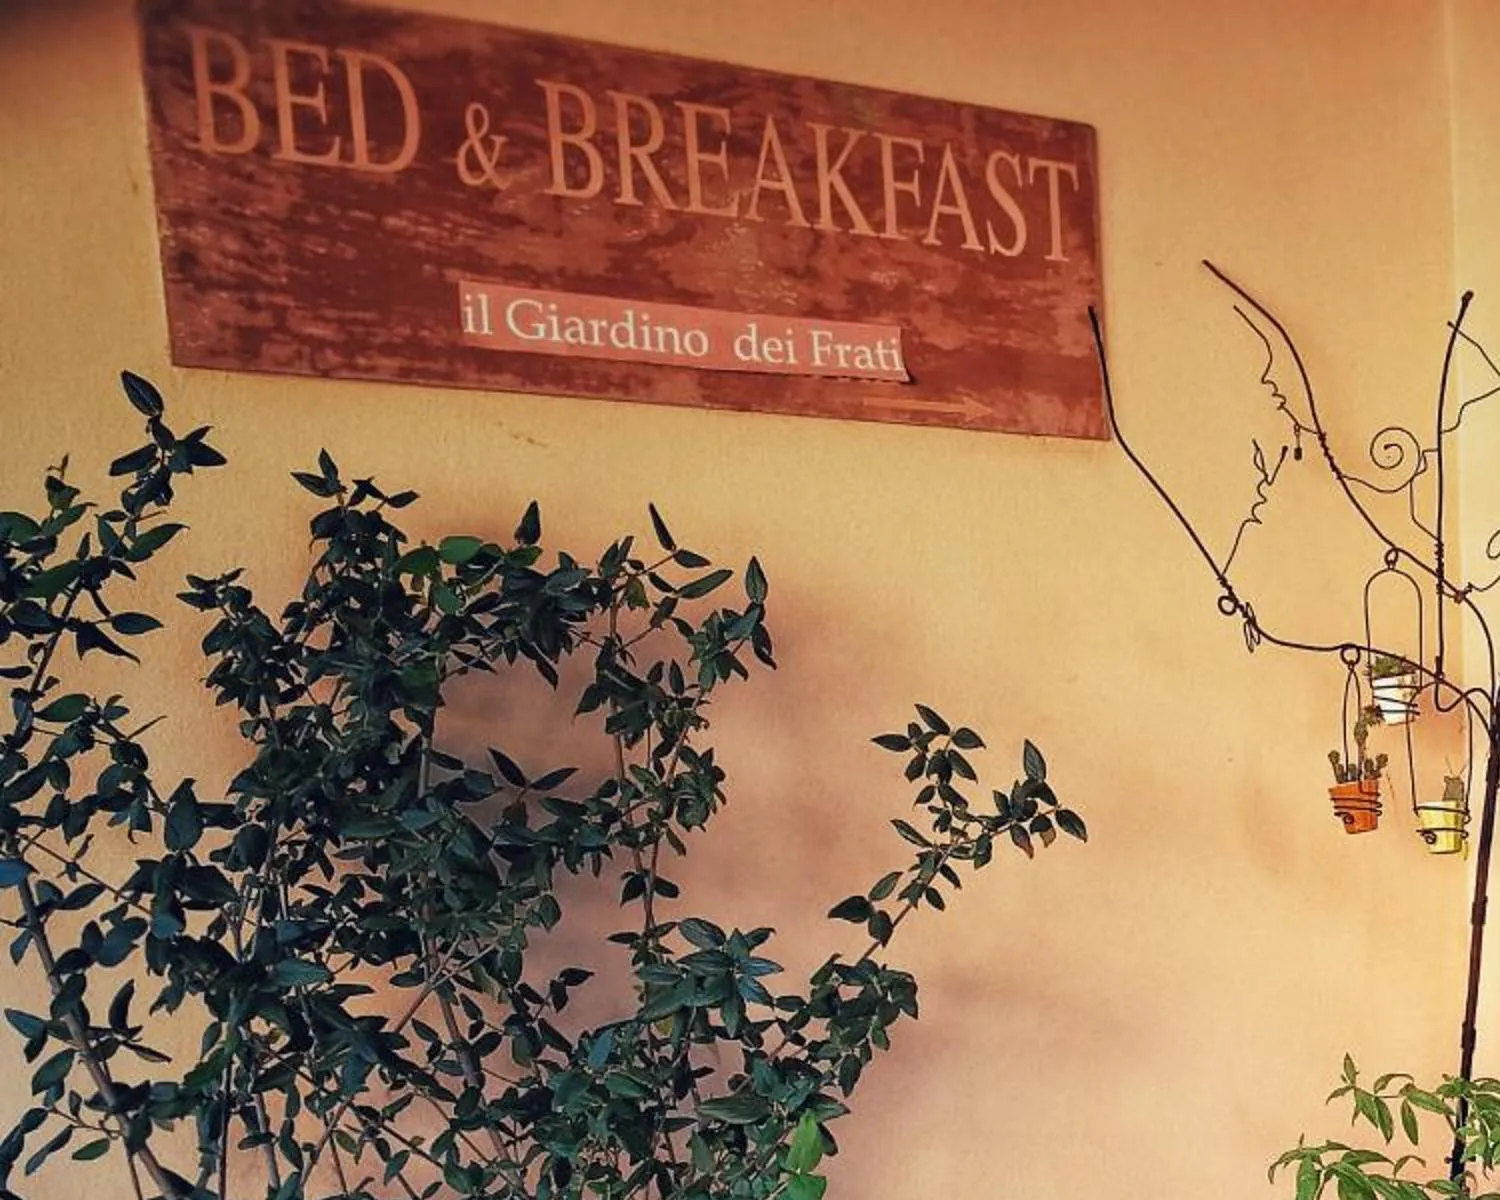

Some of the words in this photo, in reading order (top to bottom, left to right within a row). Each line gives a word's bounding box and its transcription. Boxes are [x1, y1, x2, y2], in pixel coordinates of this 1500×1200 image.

[186, 25, 421, 174] BED
[457, 102, 510, 191] &
[534, 78, 1079, 263] BREAKFAST
[462, 293, 493, 336] il
[505, 299, 709, 358] Giardino
[734, 323, 799, 365] dei
[810, 329, 907, 372] Frati
